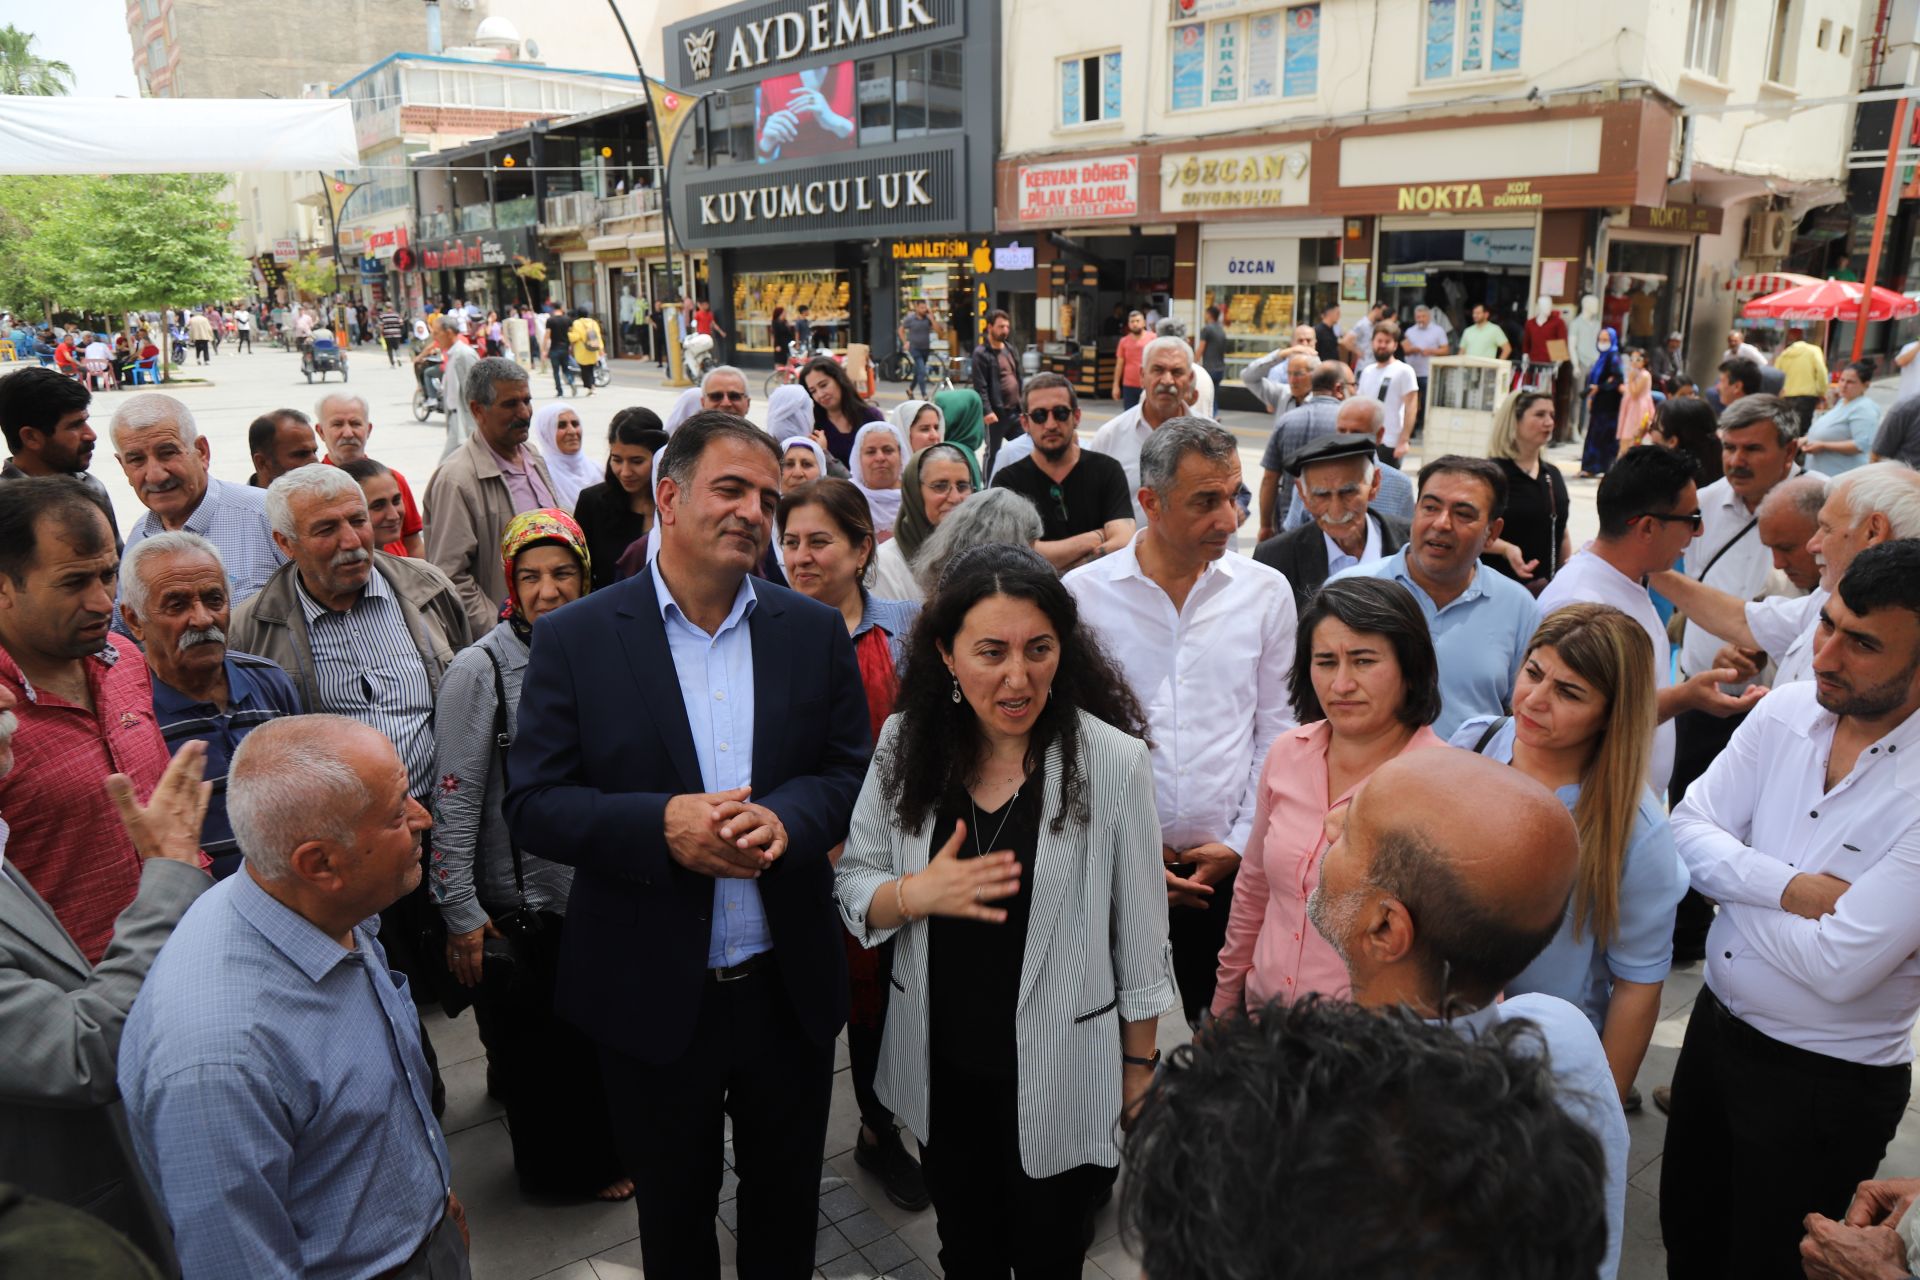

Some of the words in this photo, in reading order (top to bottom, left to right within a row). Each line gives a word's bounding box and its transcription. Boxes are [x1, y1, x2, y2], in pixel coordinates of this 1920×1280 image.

[1026, 168, 1077, 188] KERVAN
[1082, 163, 1128, 183] DÖNER
[1181, 155, 1285, 186] ÖZCAN
[700, 168, 933, 225] KUYUMCULUK
[1028, 188, 1065, 207] PİLAV
[1070, 185, 1126, 205] SALONU
[1398, 183, 1484, 211] NOKTA
[1507, 181, 1531, 194] KOT
[1493, 193, 1543, 207] DÜNYASI
[1649, 207, 1688, 230] NOKTA
[892, 240, 924, 258] DİLAN
[923, 239, 968, 258] İLETİŞİM
[1229, 257, 1275, 274] ÖZCAN
